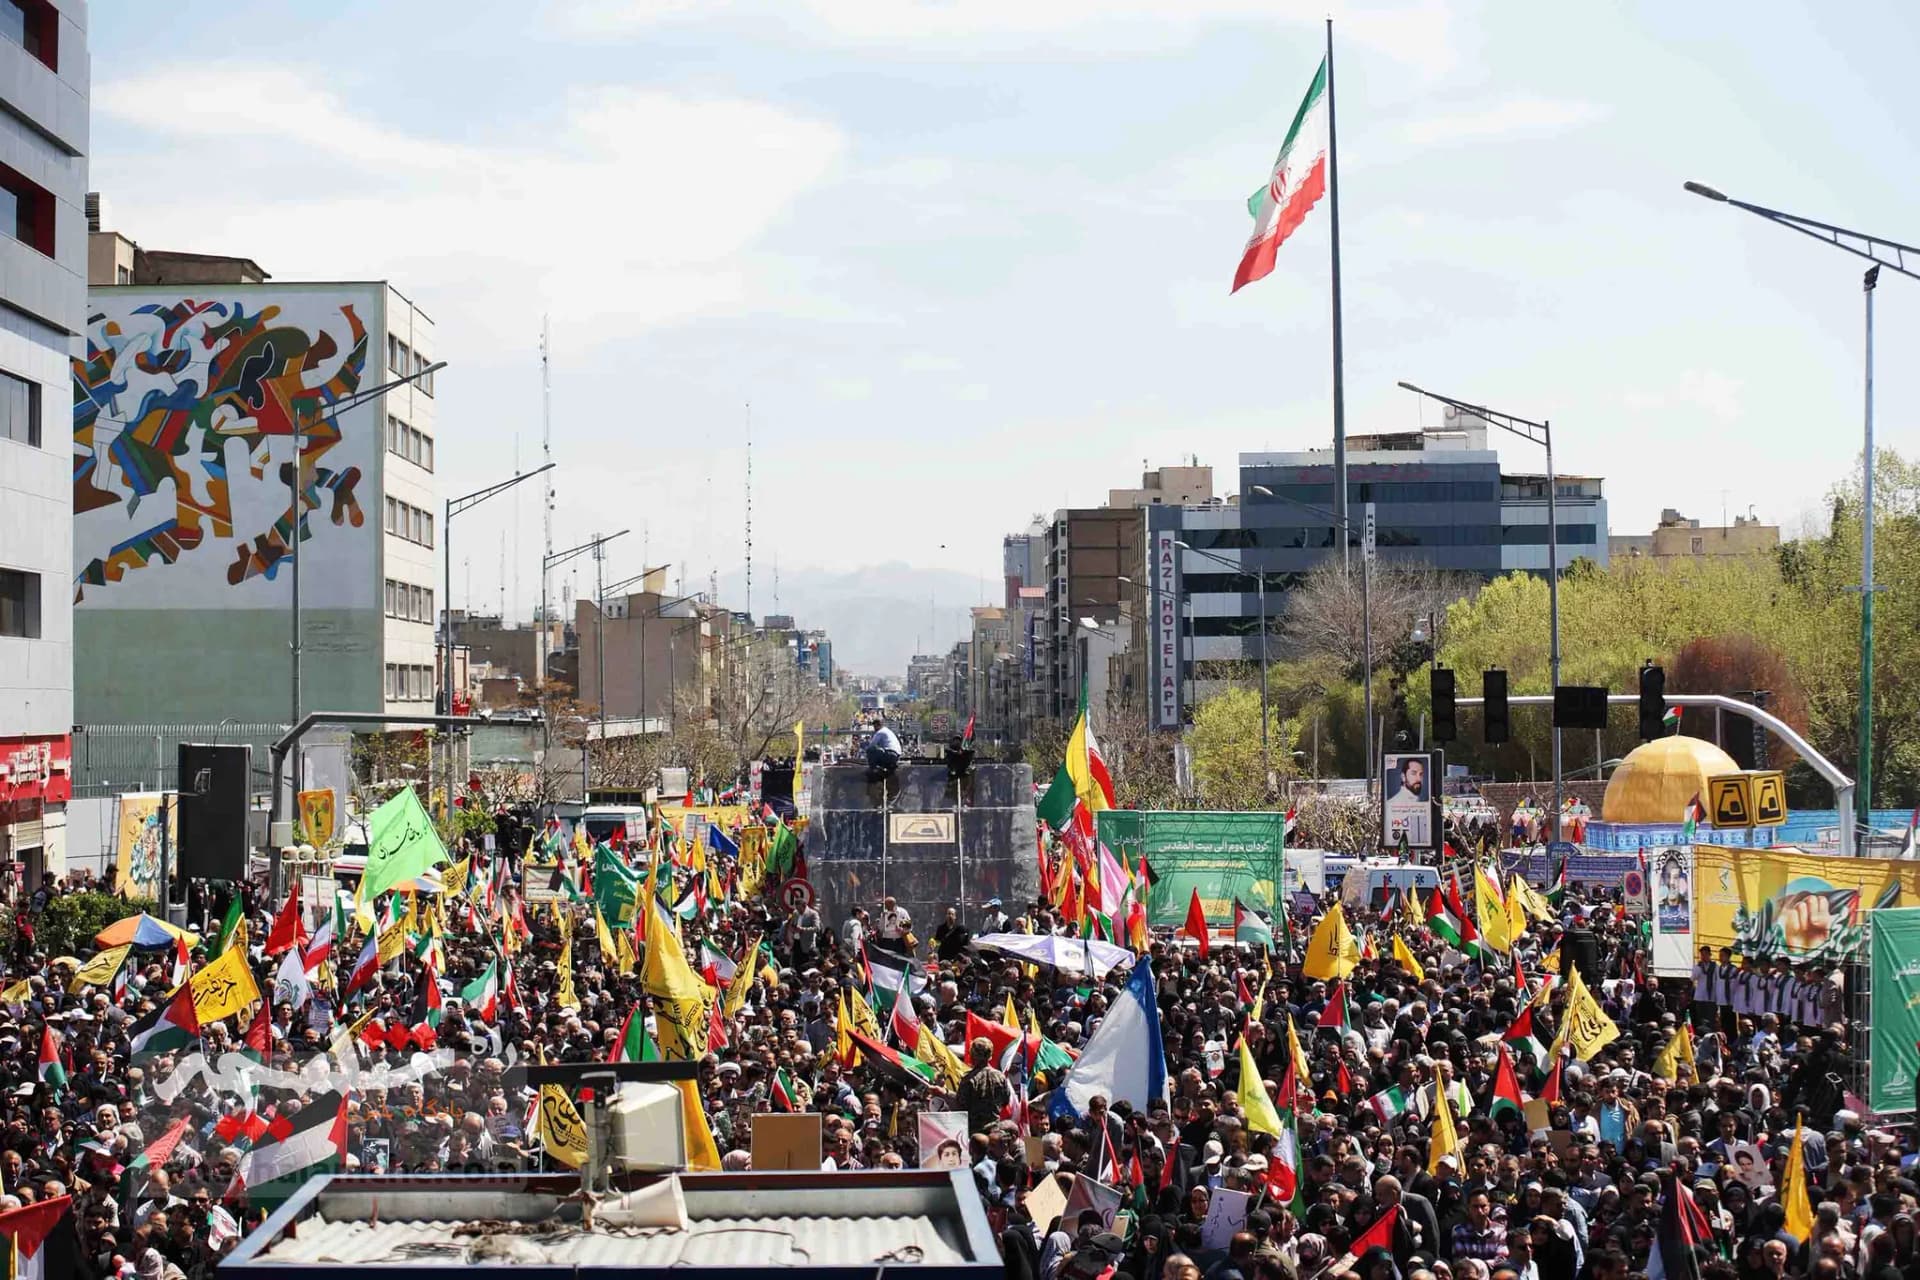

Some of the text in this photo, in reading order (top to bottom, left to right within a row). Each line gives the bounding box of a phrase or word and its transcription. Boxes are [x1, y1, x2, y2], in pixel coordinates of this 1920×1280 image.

[1160, 538, 1175, 717] RAZI HOTEL APT
